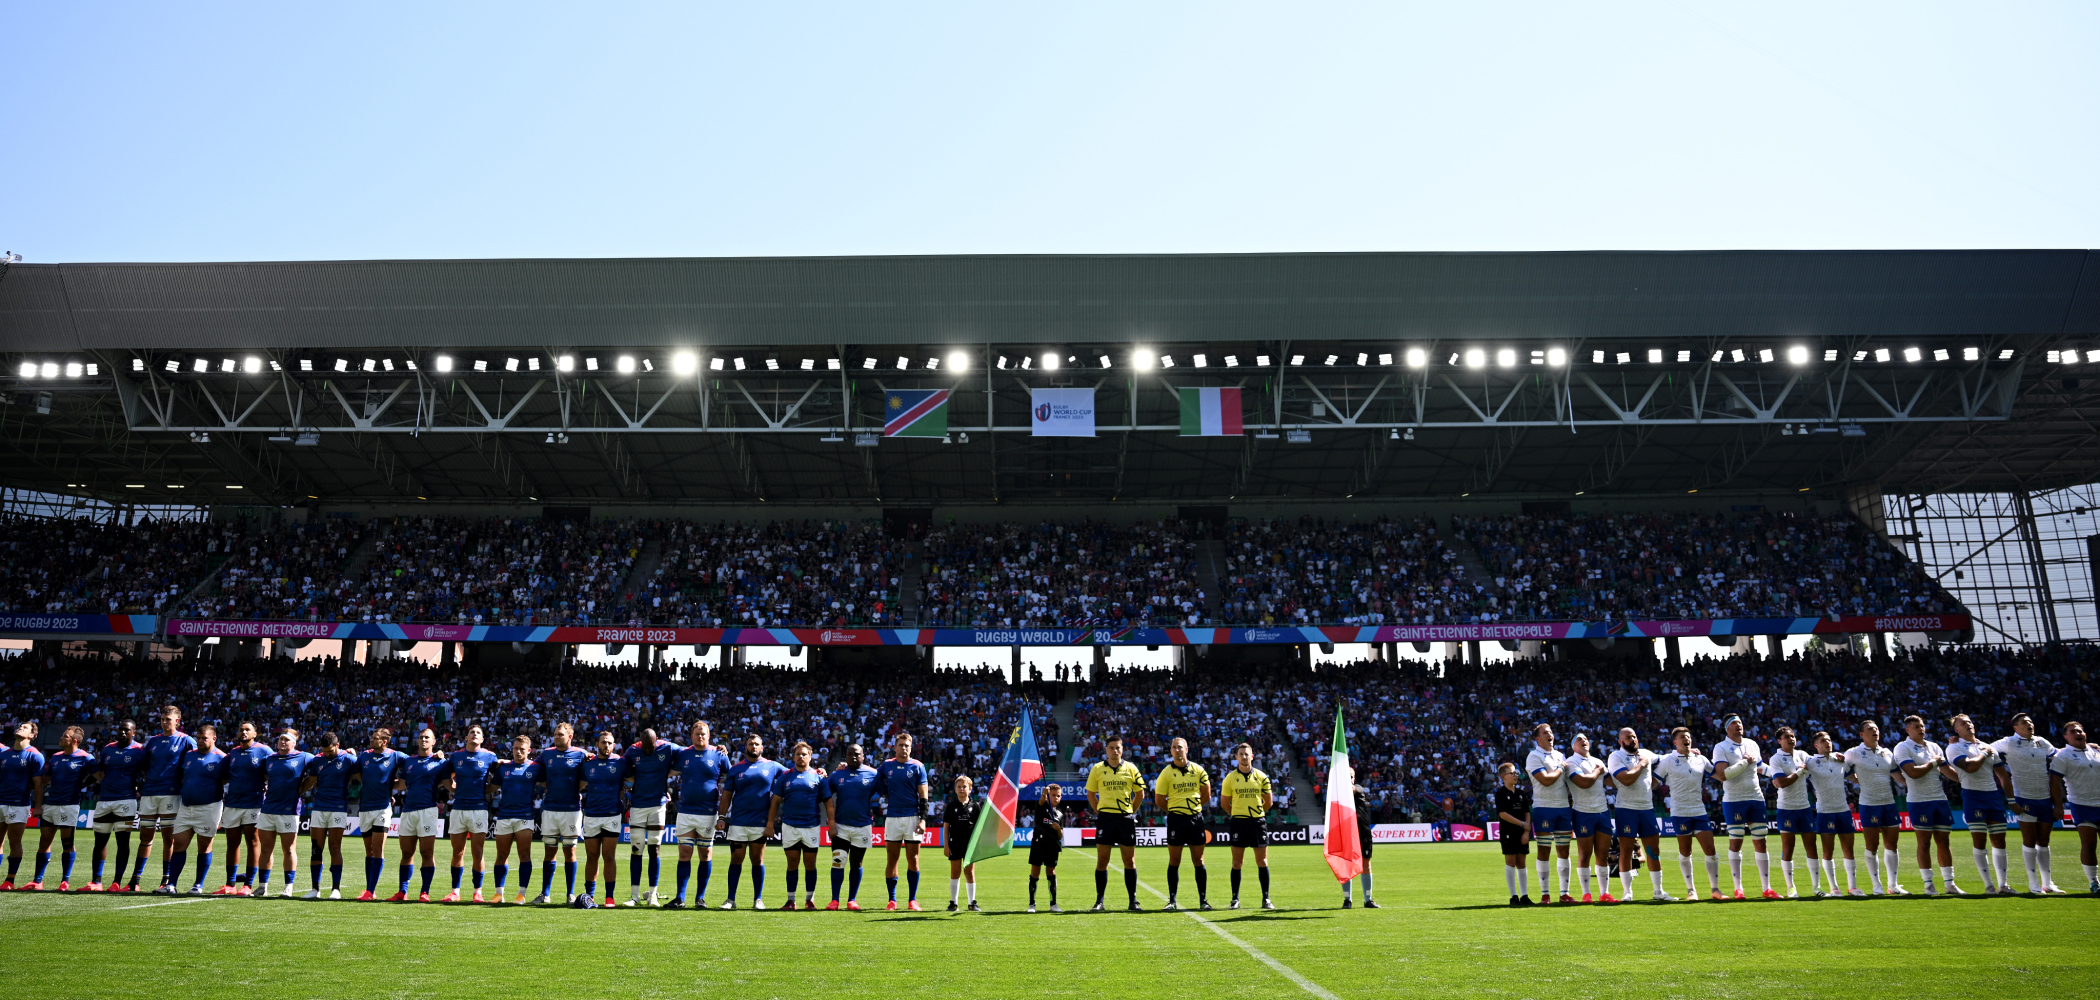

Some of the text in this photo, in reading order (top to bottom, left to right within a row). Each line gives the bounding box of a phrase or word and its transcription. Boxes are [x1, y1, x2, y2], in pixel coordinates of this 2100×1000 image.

[14, 617, 50, 628] RUGBY
[52, 618, 78, 629] 2023
[1874, 617, 1942, 630] #RWC2023
[647, 630, 676, 642] 2023
[976, 632, 1017, 642] RUGBY
[1020, 632, 1064, 642] WORLD
[1095, 632, 1124, 642] 20
[1372, 829, 1428, 838] SUPER TRY
[1453, 830, 1482, 840] SNCF
